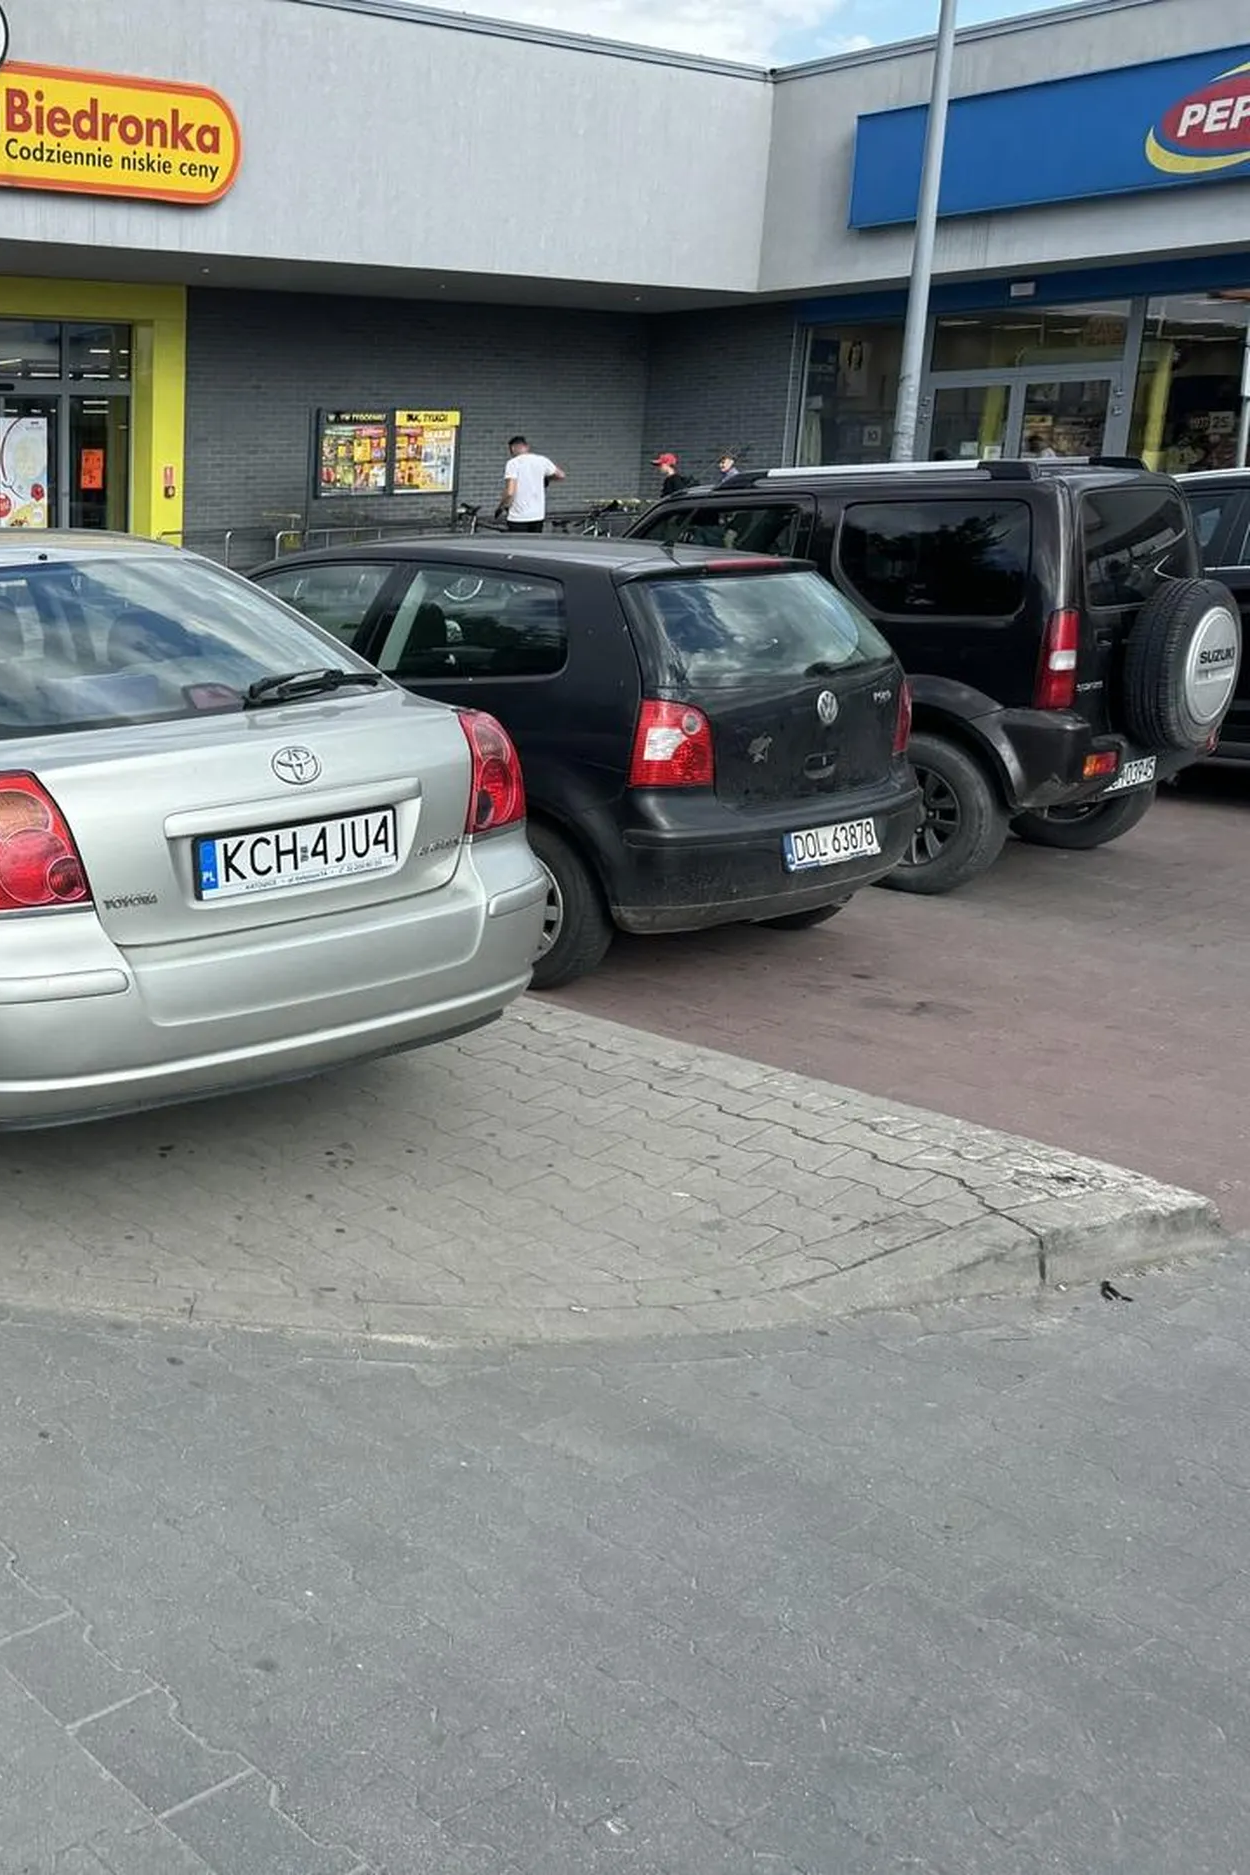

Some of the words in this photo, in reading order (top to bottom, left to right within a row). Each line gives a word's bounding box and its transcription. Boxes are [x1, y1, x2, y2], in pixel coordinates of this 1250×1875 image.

[4, 87, 221, 154] Biedronka
[4, 137, 114, 169] Codziennie
[120, 150, 173, 175] niskie
[179, 161, 220, 183] ceny
[1200, 646, 1235, 664] SUZUKI
[222, 830, 300, 883] KCH
[310, 814, 390, 865] 4JU4
[793, 831, 828, 861] DOL
[832, 820, 874, 853] 63878
[202, 871, 217, 883] PL
